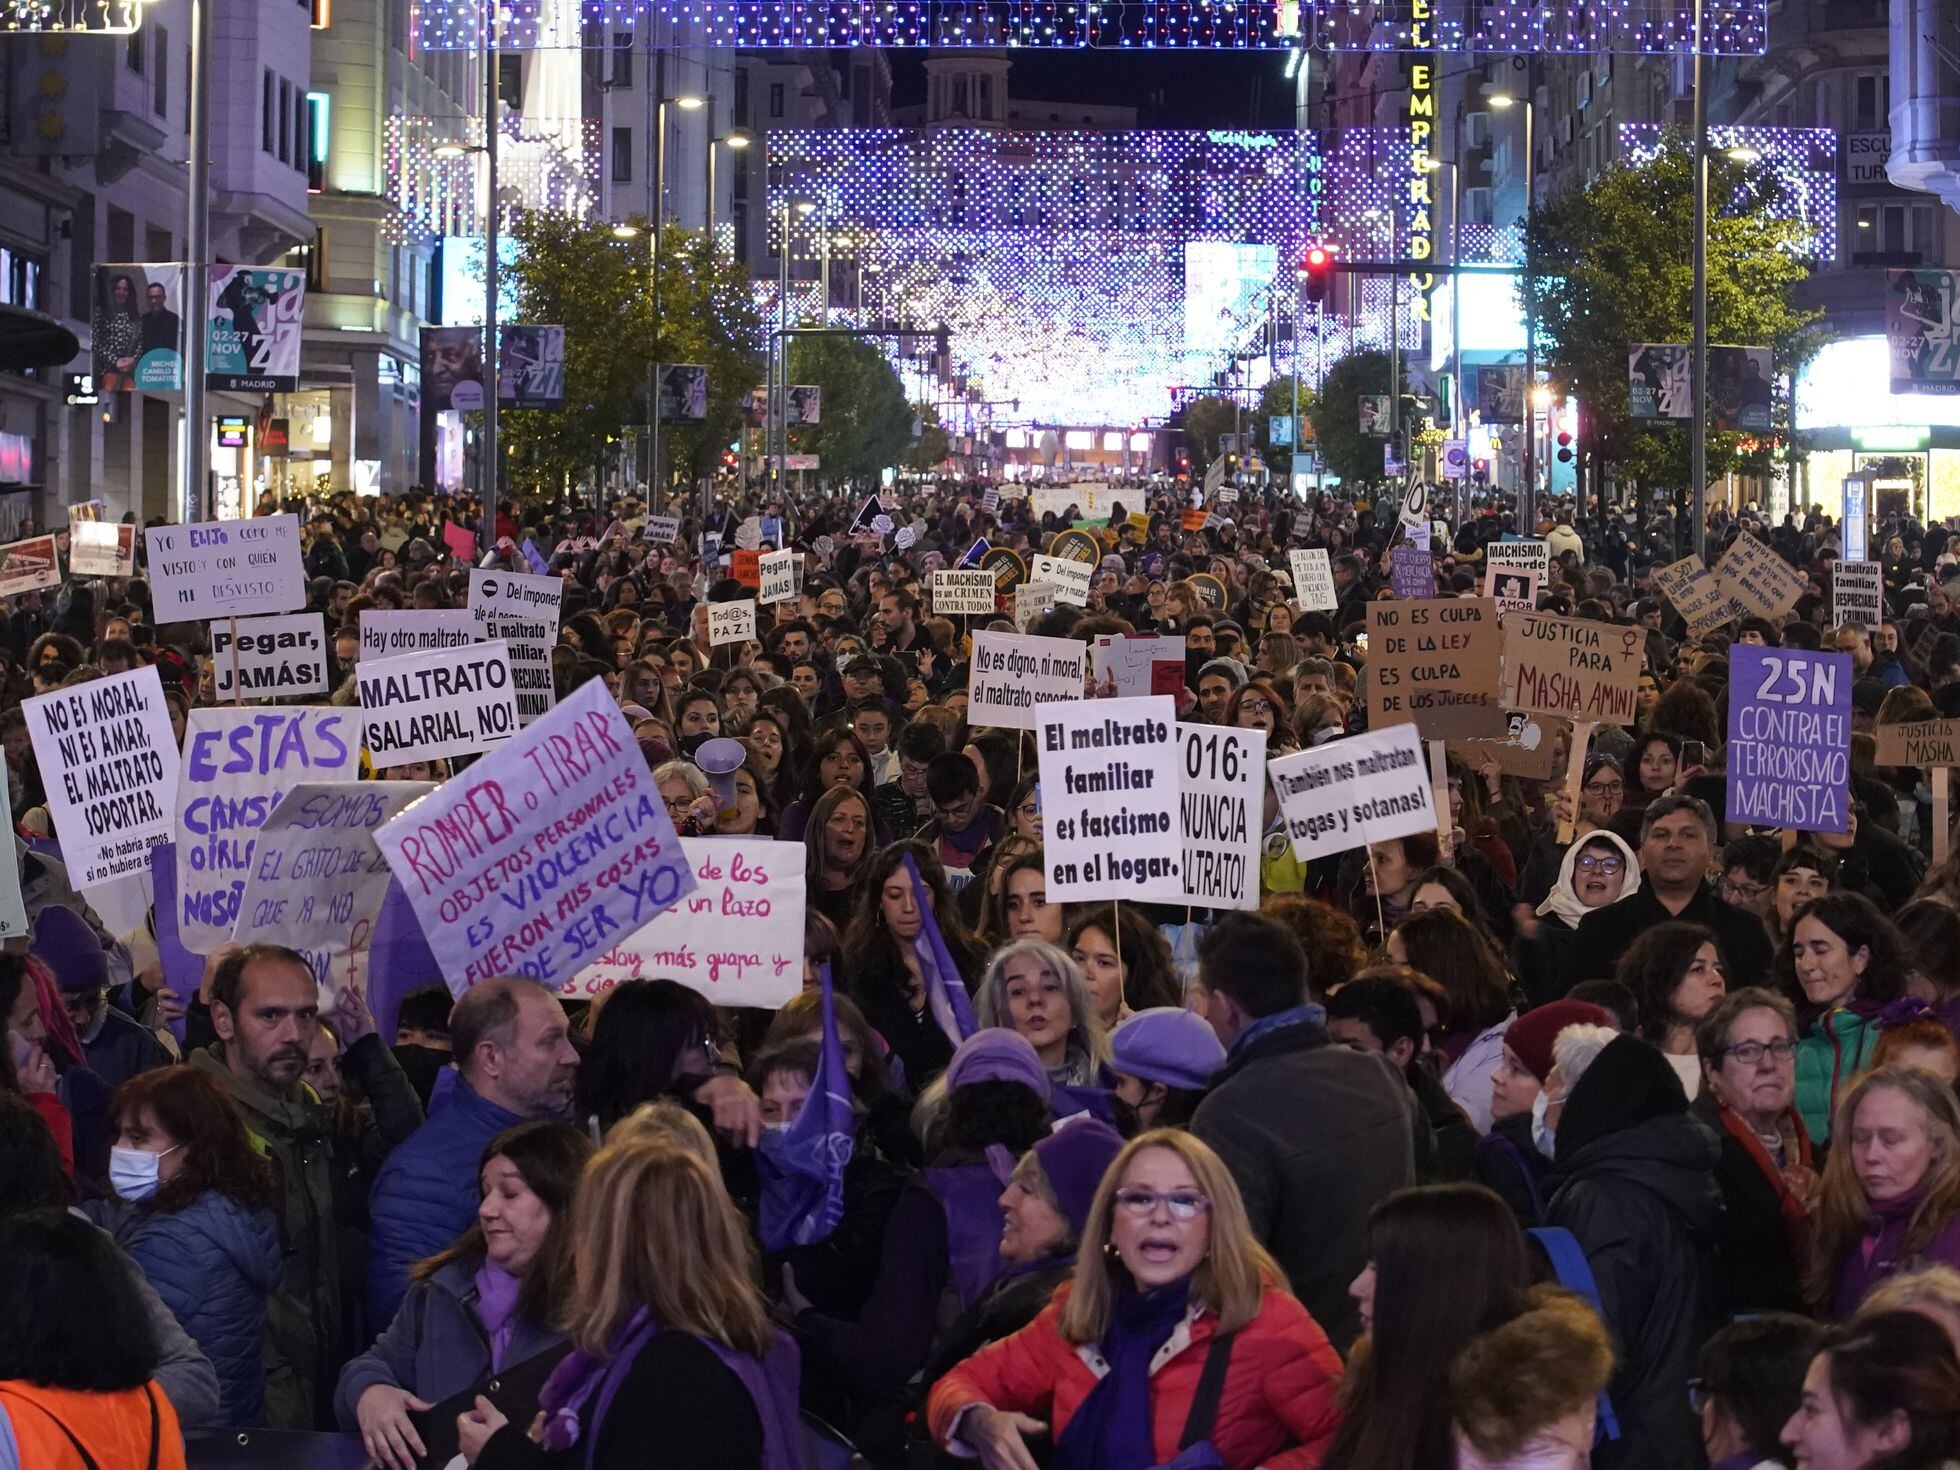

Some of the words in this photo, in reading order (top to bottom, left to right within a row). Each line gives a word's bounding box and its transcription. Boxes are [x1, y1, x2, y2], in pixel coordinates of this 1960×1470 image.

[1410, 65, 1433, 322] EMPERADOR
[212, 331, 249, 342] 02-27
[212, 343, 241, 355] NOV
[241, 380, 276, 389] MADRID
[155, 535, 175, 552] YO
[189, 527, 229, 548] ELIJO
[162, 560, 196, 577] VISTO
[216, 557, 236, 570] CON
[761, 560, 790, 576] Pegar,
[935, 574, 944, 586] EL
[1056, 564, 1067, 575] Del
[1674, 562, 1693, 578] SOY
[1835, 564, 1842, 573] El
[1844, 564, 1878, 575] maltrato
[507, 582, 522, 599] Del
[524, 585, 561, 607] imponer,
[954, 588, 992, 599] CRIMEN
[1835, 577, 1878, 591] familiar,
[934, 601, 965, 612] CONTRA
[967, 601, 992, 612] TODOS
[1499, 599, 1533, 611] AMOR
[1835, 593, 1878, 608] DESPRECIABLE
[487, 622, 498, 639] El
[501, 622, 545, 639] maltrato
[1377, 610, 1399, 627] NO
[1411, 609, 1429, 624] ES
[1440, 607, 1482, 623] CULPA
[214, 630, 319, 655] Pegar,
[363, 627, 387, 653] Hay
[391, 629, 415, 648] otro
[419, 627, 469, 648] maltrato
[1386, 637, 1406, 654] DE
[1418, 636, 1437, 651] LA
[1441, 633, 1472, 650] LEY
[1522, 618, 1600, 648] JUSTICIA
[218, 660, 321, 691] JAMÁS!
[977, 645, 990, 669] No
[993, 655, 1005, 670] es
[1007, 651, 1039, 677] digno,
[1041, 654, 1050, 674] ni
[1052, 656, 1083, 682] moral,
[1379, 667, 1399, 686] ES
[1411, 664, 1461, 682] CULPA
[1570, 648, 1612, 672] PARA
[360, 659, 506, 709] MALTRATO
[974, 684, 985, 703] el
[986, 684, 1032, 708] maltrato
[1516, 663, 1582, 712] MASHA
[1587, 681, 1634, 718] AMINI
[1756, 656, 1836, 706] 25N
[43, 700, 69, 735] NO
[72, 695, 88, 728] ES
[90, 680, 149, 724] MORAL,
[1383, 695, 1402, 712] DE
[1409, 693, 1434, 709] LOS
[1437, 689, 1489, 707] JUECES
[368, 710, 474, 753] SALARIAL,
[477, 702, 514, 735] NO!
[1045, 722, 1064, 751] El
[1071, 718, 1168, 751] maltrato
[1739, 705, 1822, 745] CONTRA
[1826, 715, 1848, 748] EL
[1898, 723, 1953, 738] JUSTICIA
[58, 735, 80, 769] NI
[81, 729, 98, 764] ES
[99, 717, 151, 758] AMAR,
[189, 709, 347, 782] ESTÁS
[1186, 733, 1248, 783] 016:
[1905, 740, 1955, 765] MASHA
[63, 771, 83, 806] EL
[86, 750, 163, 800] MALTRATO
[1064, 761, 1154, 795] familiar
[1333, 761, 1354, 782] nos
[1355, 744, 1418, 777] maltratan
[1731, 740, 1847, 785] TERRORISMO
[84, 789, 163, 837] SOPORTAR.
[287, 792, 388, 829] SOMOS
[400, 780, 522, 896] ROMPER
[524, 711, 622, 797] TIRAR
[1290, 811, 1336, 840] togas
[1338, 807, 1348, 832] y
[1353, 784, 1427, 823] sotanas!
[1735, 780, 1839, 826] MACHISTA
[1057, 814, 1075, 841] es
[1081, 806, 1170, 837] fascismo
[116, 836, 143, 856] habría
[439, 846, 533, 924] OBJETOS
[534, 767, 637, 852] PERSONALES
[87, 867, 94, 882] si
[97, 864, 108, 879] no
[109, 857, 142, 877] hubiera
[258, 850, 280, 882] EL
[291, 847, 339, 880] GRITO
[466, 915, 494, 949] ES
[500, 794, 655, 911] VIOLENCIA
[698, 854, 722, 880] de
[730, 852, 769, 885] los
[1054, 862, 1077, 884] en
[1084, 854, 1100, 882] el
[1107, 852, 1179, 884] hogar.
[252, 898, 288, 928] QUE
[296, 896, 314, 923] YA
[327, 891, 354, 924] NO
[465, 912, 554, 987] FUERON
[557, 884, 592, 921] MIS
[596, 837, 662, 889] COSAS
[564, 904, 619, 959] SER
[619, 865, 680, 923] YO
[689, 897, 712, 914] un
[721, 886, 771, 917] lazo
[655, 944, 697, 968] más
[706, 952, 764, 982] guapa
[772, 954, 792, 977] y
